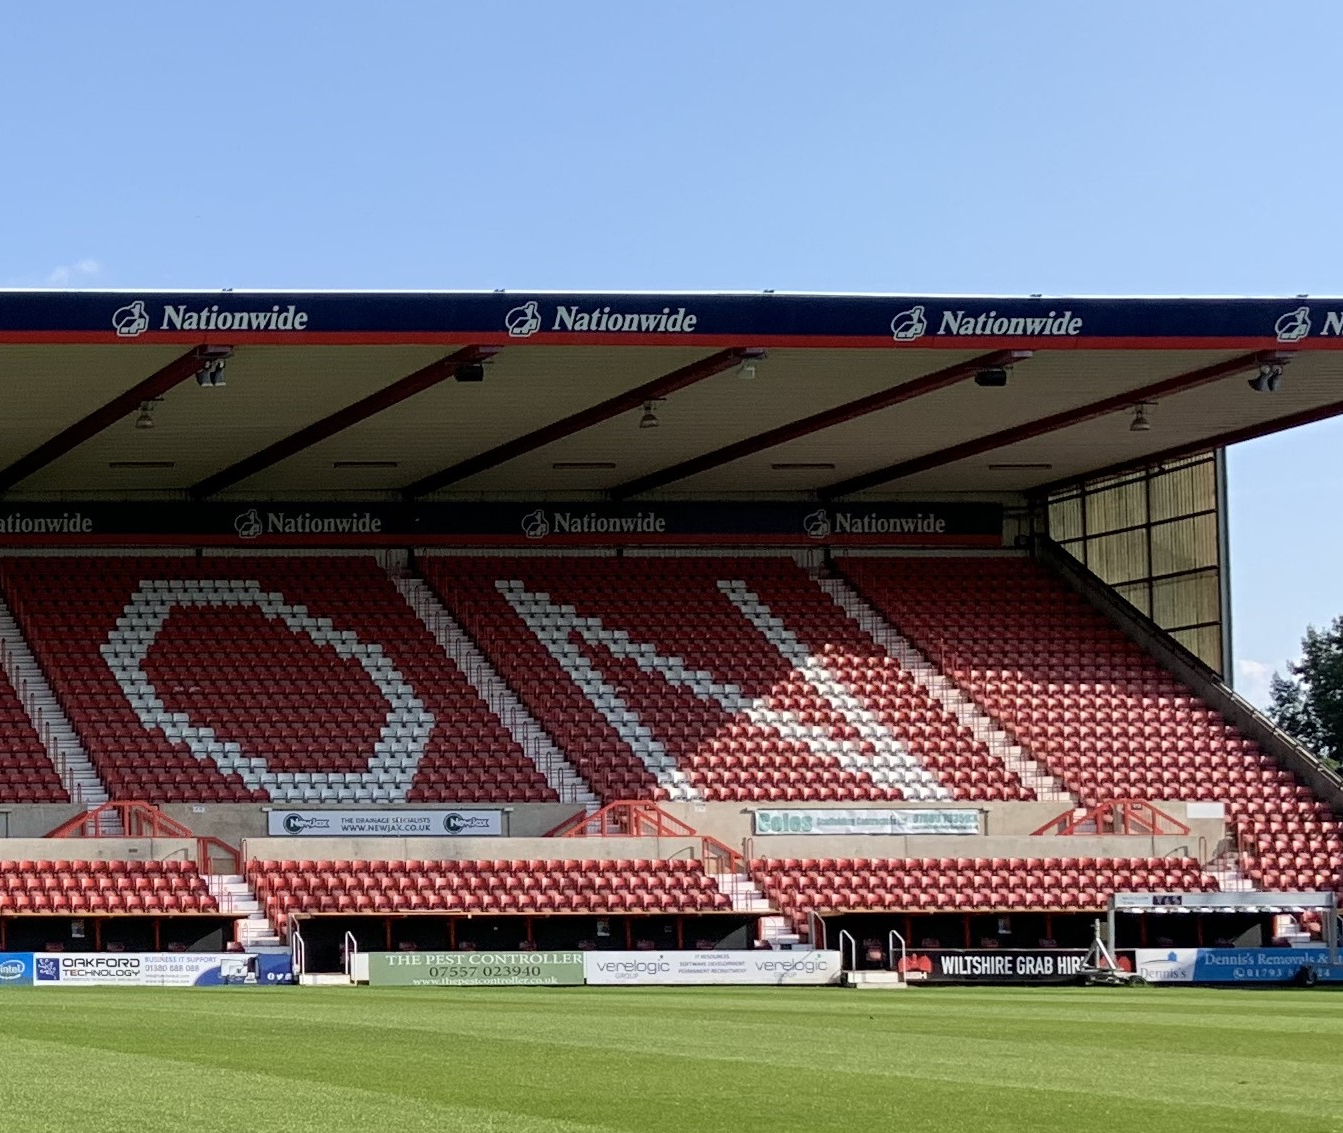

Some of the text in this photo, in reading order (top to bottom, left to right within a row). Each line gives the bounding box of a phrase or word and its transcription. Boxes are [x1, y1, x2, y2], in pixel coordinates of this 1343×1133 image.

[160, 305, 308, 330] Nationwide
[551, 305, 697, 332] Nationwide
[938, 311, 1083, 336] Nationwide
[267, 512, 382, 533] Nationwide
[554, 513, 666, 533] Nationwide
[835, 513, 946, 533] Nationwide
[62, 958, 141, 968] OAKFORD
[386, 953, 583, 966] THE PEST CONTROLLER
[596, 955, 671, 975] verelogic
[754, 954, 828, 974] verelogic
[940, 956, 1013, 975] WILTSHIRE
[1016, 956, 1053, 975] GRAB
[1205, 953, 1254, 965] Dennis's
[1257, 953, 1314, 965] Removals
[1317, 953, 1329, 964] &
[62, 969, 141, 977] TECHNOLOGY
[412, 976, 559, 986] www.thepestcontroller.co.uk
[429, 966, 541, 978] 07557 023940
[1140, 968, 1187, 979] Dennis's
